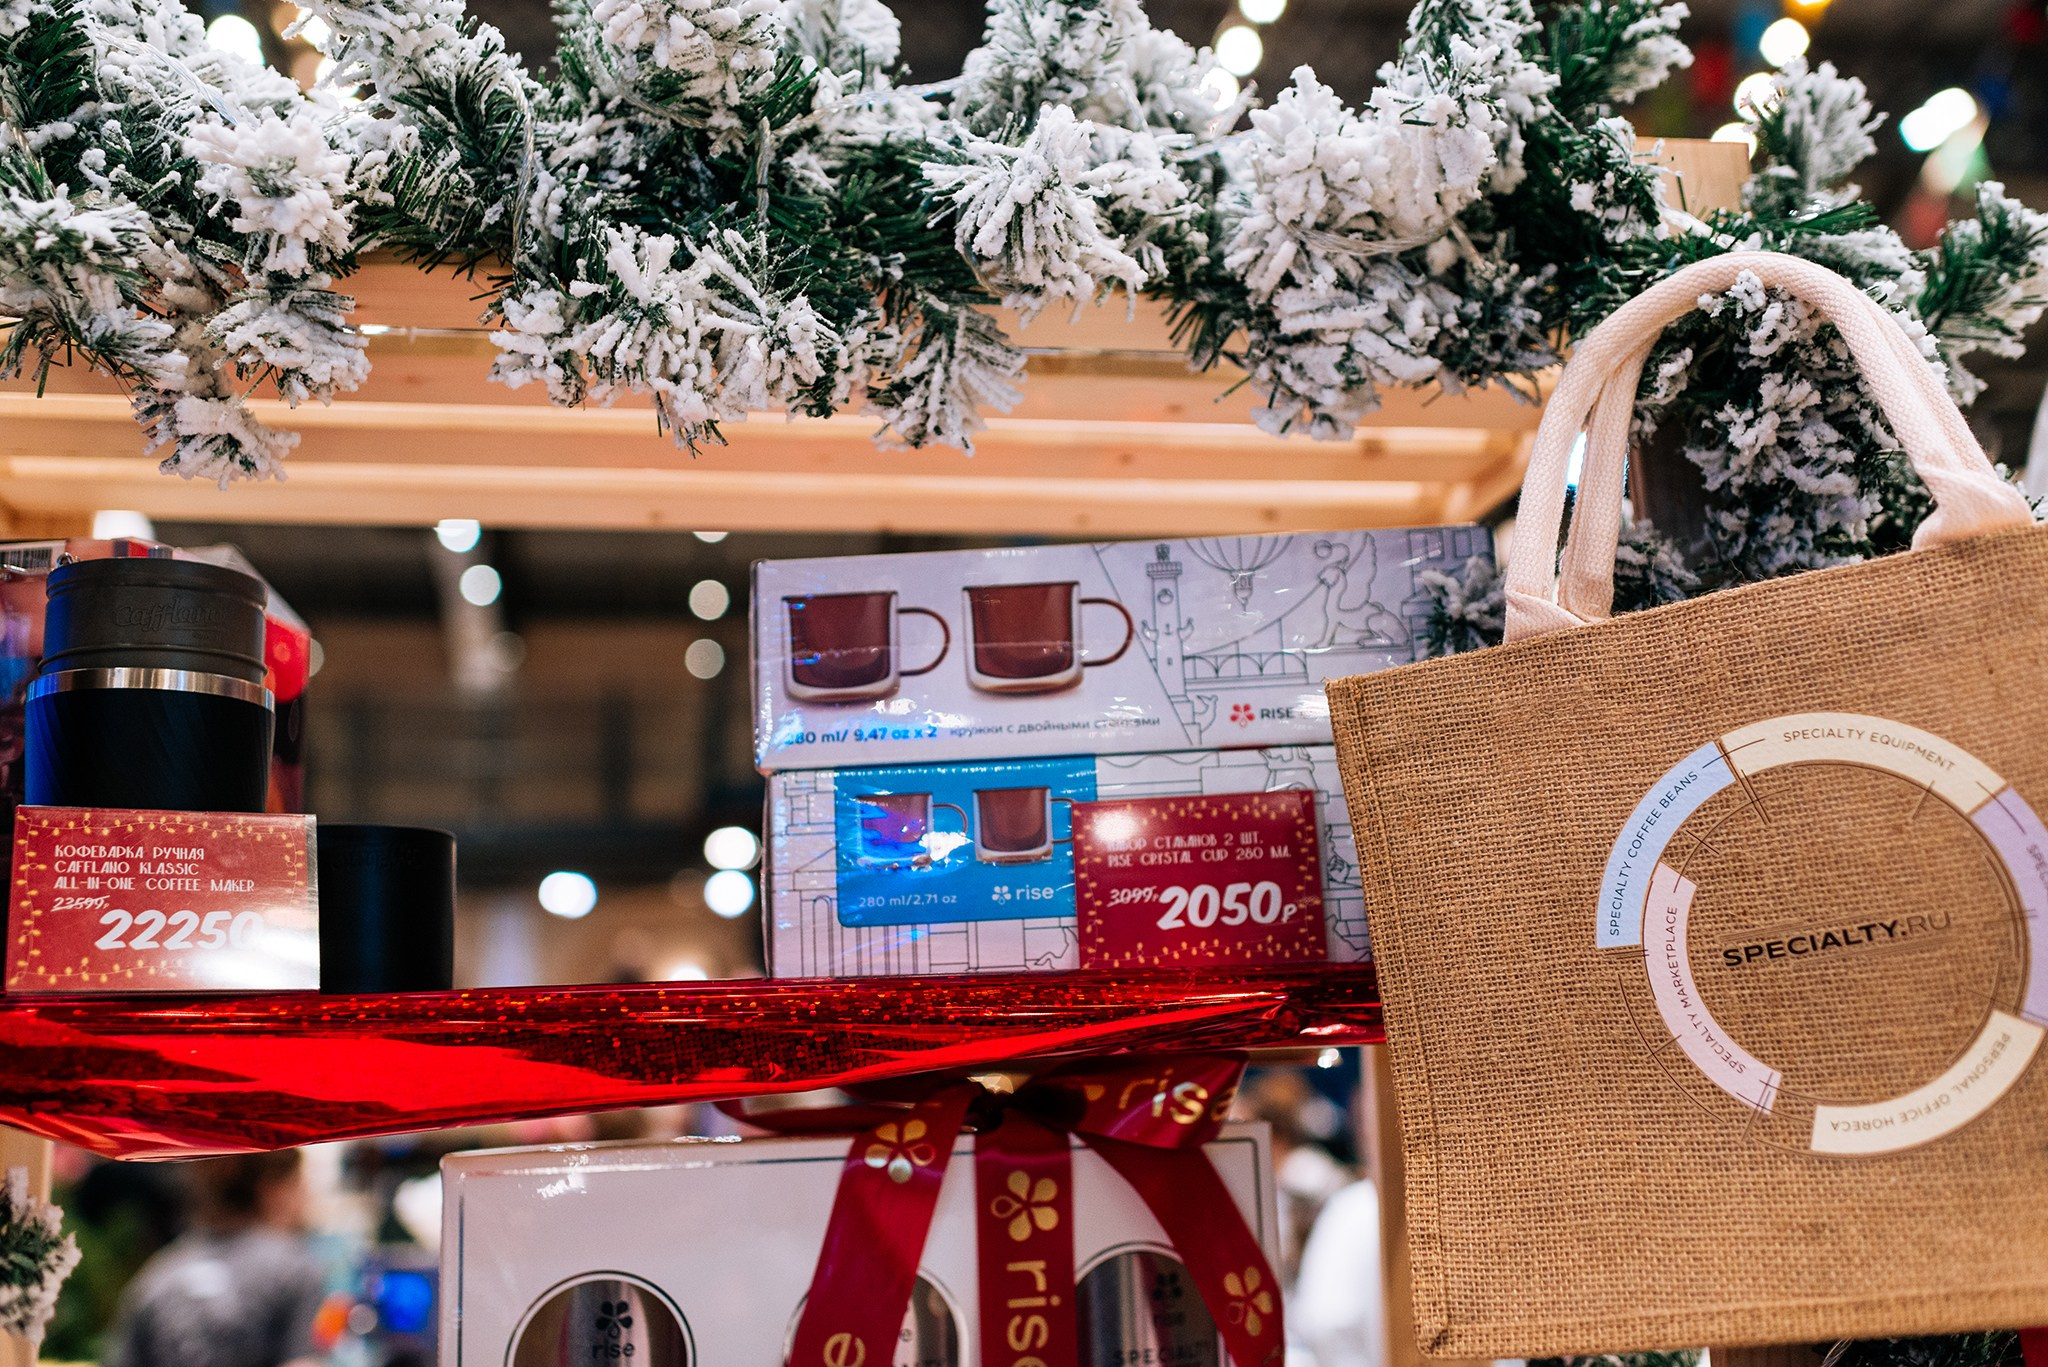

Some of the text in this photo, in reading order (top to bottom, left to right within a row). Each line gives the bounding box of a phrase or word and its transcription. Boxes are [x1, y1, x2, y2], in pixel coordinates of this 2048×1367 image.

[1260, 708, 1296, 719] RISE
[1018, 719, 1090, 733] двойными
[891, 730, 909, 740] oz
[1783, 728, 1956, 772] SPECIALTY EQUIPMENT
[1224, 833, 1234, 846] 2
[54, 844, 205, 860] КОФЕВАРКА РУЧНАЯ
[1140, 850, 1194, 866] CRYSTAL
[1201, 848, 1228, 862] CUP
[1235, 846, 1263, 861] 280
[1610, 771, 1698, 936] SPECIALTY COFFEE BEANS
[54, 861, 199, 875] CAFFLANO KLASSIC
[54, 876, 254, 892] ALL-IN-ONE COFFEE MAKER
[1016, 884, 1054, 900] rise
[859, 896, 885, 907] 280
[942, 895, 957, 904] oz
[1722, 910, 1950, 967] SPECIALTY.RU
[1665, 906, 1747, 1074] SPECIALTY MARKETPLACE
[1830, 1032, 2011, 1131] PERSONAL OFFICE HORECA
[592, 1342, 635, 1359] rise
